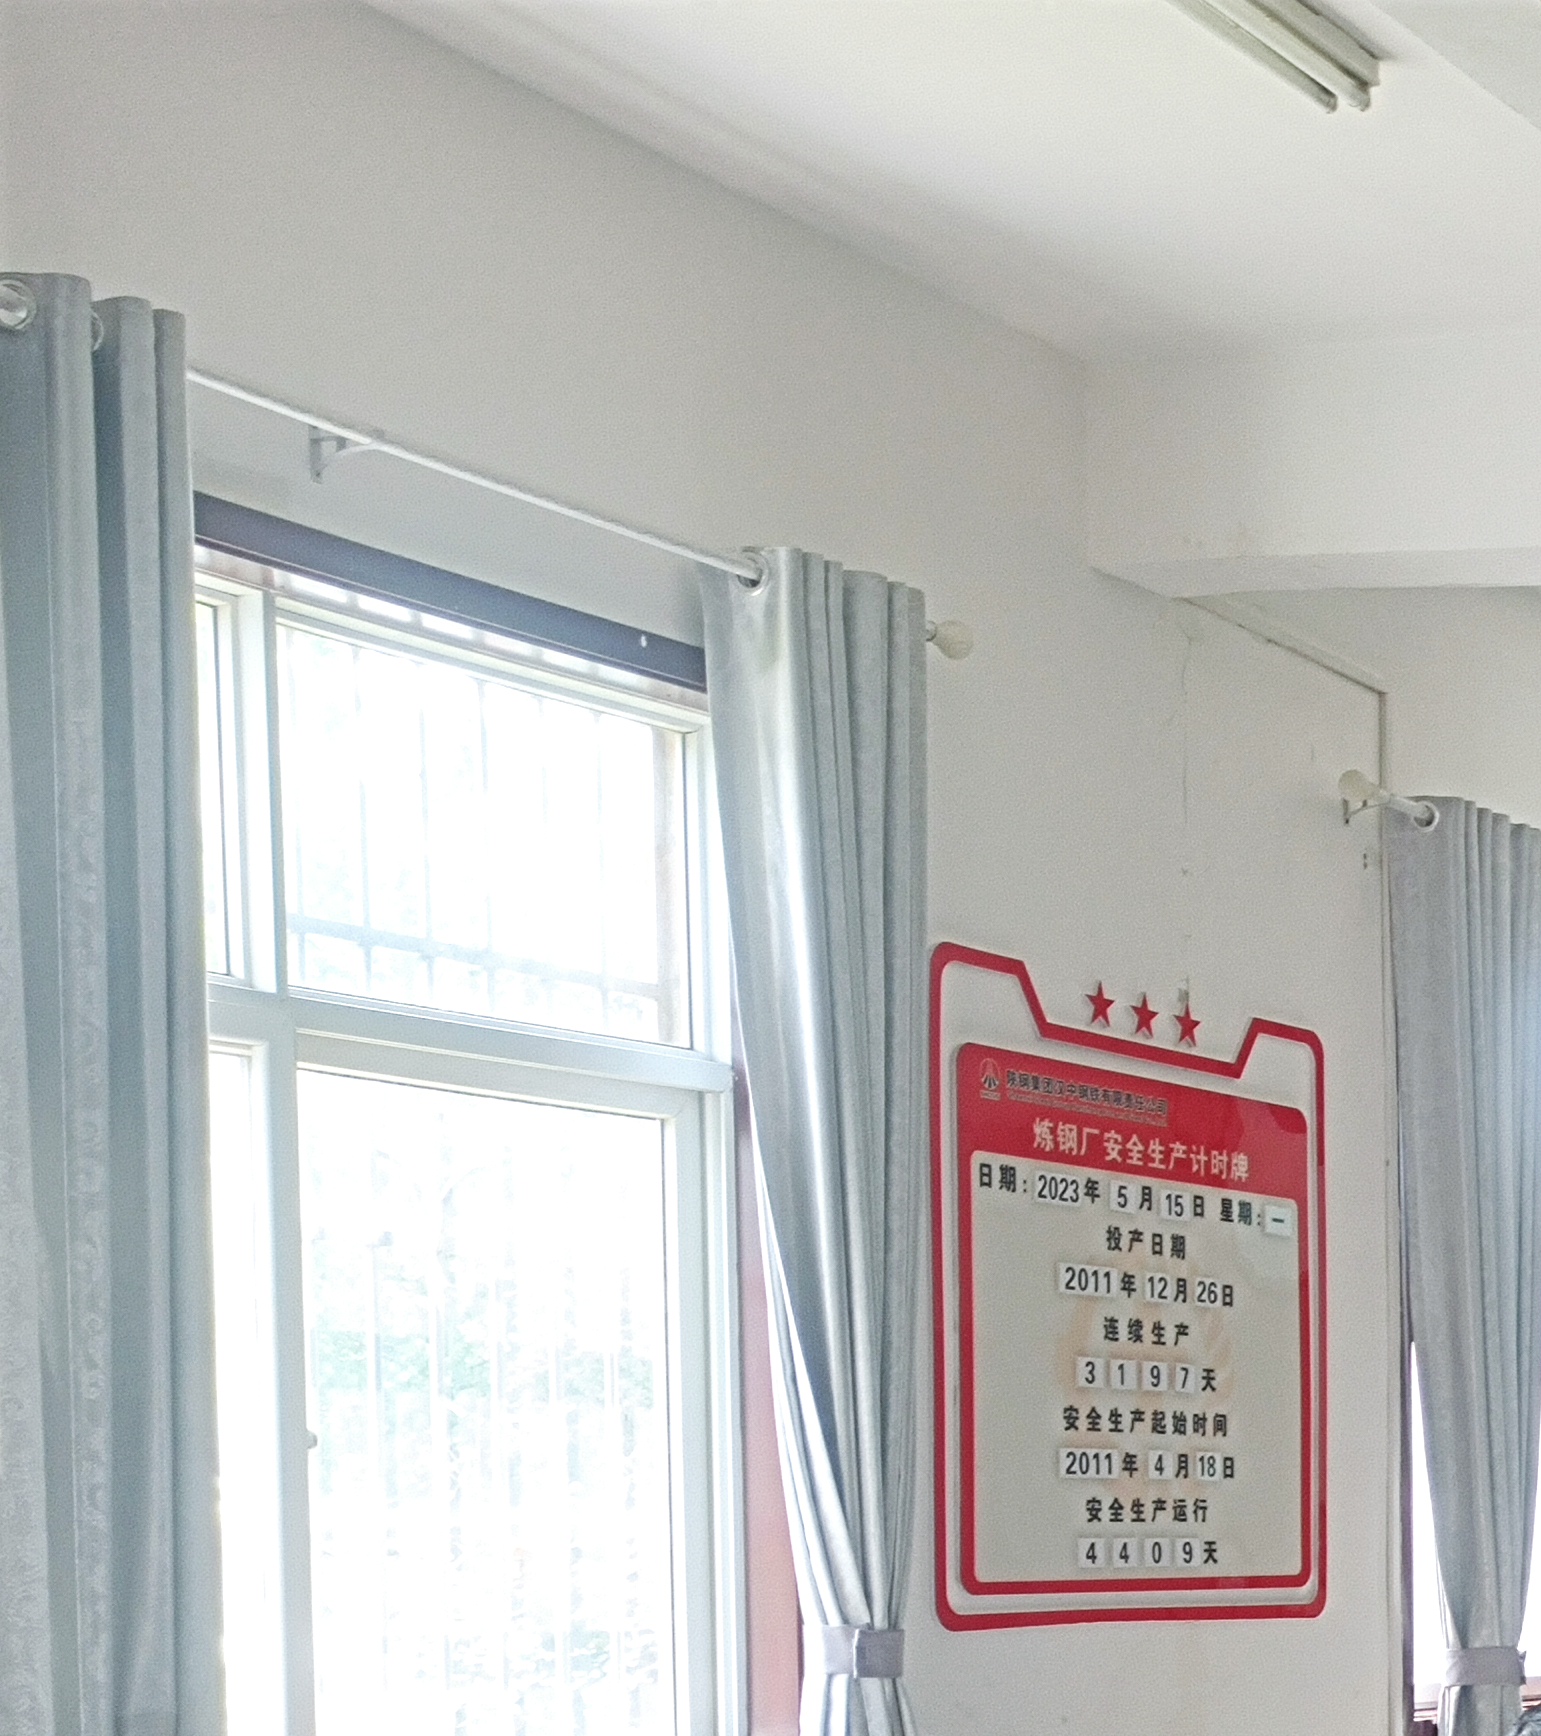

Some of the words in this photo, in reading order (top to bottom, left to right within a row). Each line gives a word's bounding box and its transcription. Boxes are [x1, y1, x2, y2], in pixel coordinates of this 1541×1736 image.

[1032, 1117, 1250, 1182] 炼钢厂安全生产计时牌
[1105, 1225, 1187, 1261] 投产日期
[1102, 1316, 1190, 1347] 连续生产
[1062, 1404, 1228, 1438] 安全生产起始时间
[1085, 1496, 1209, 1524] 安全生产运行
